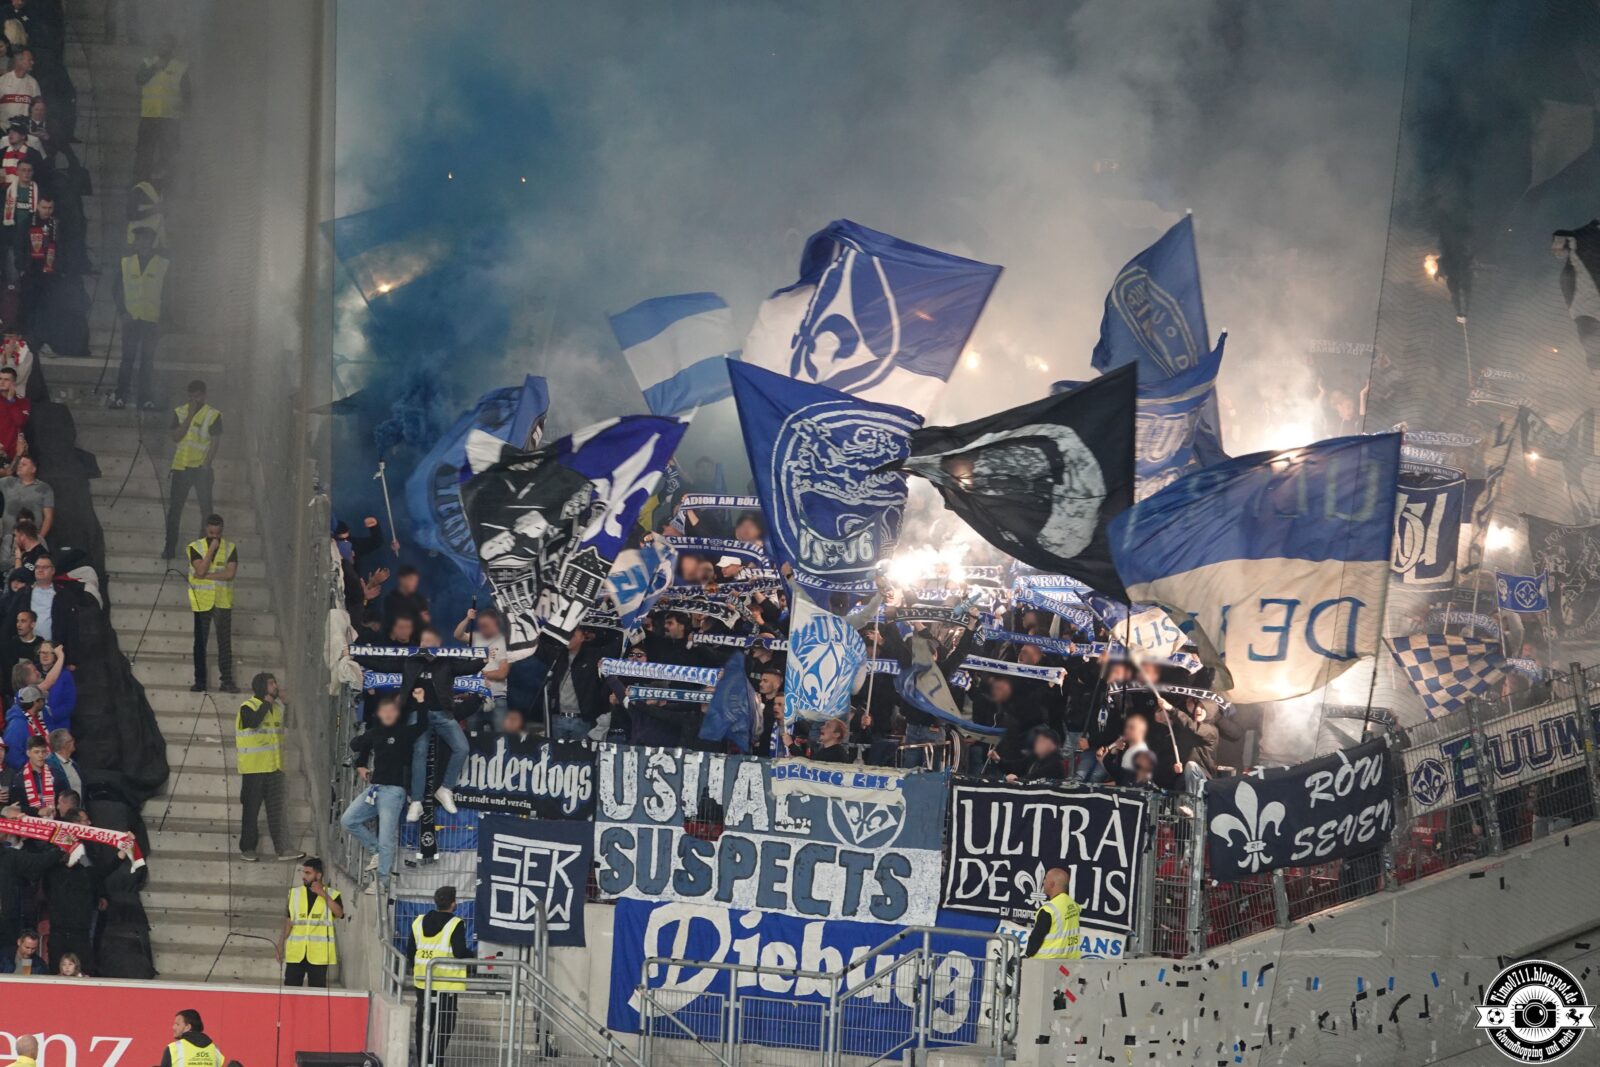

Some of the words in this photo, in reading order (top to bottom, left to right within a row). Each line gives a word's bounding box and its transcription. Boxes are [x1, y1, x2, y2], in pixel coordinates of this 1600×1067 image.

[684, 496, 716, 506] ADION
[719, 496, 734, 506] AM
[736, 495, 761, 506] BÖLL
[693, 633, 747, 647] UNDER
[350, 646, 410, 656] UNDER
[865, 660, 901, 675] SUAL
[638, 688, 678, 699] USUAL
[683, 691, 714, 702] SUSP
[453, 792, 467, 802] für
[468, 795, 489, 805] stadt
[490, 797, 506, 807] und
[507, 799, 532, 809] verein
[960, 794, 1128, 868] ULTRÀ
[599, 827, 912, 921] SUSPECTS
[955, 858, 1011, 902] DE
[1068, 864, 1127, 916] LIS
